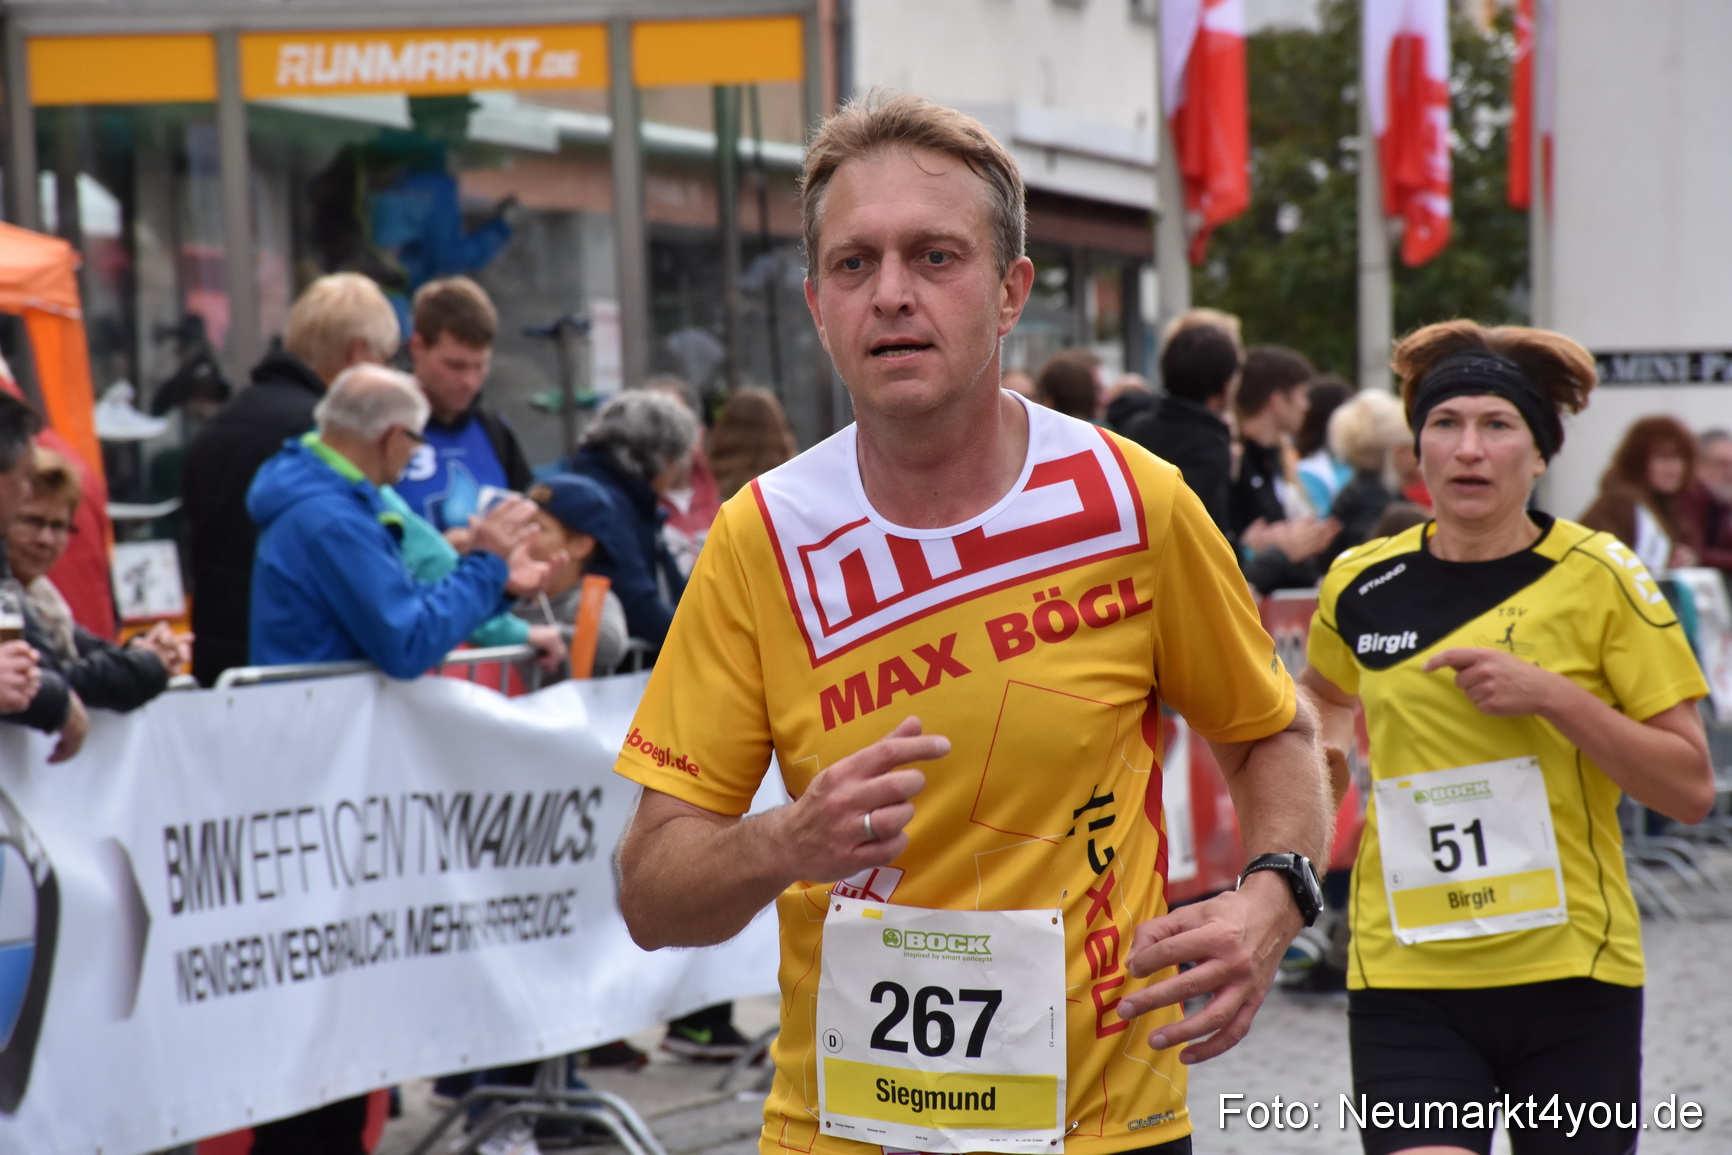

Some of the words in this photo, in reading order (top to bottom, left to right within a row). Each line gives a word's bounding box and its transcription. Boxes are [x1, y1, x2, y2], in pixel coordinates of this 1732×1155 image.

[1358, 563, 1407, 596] STANNO
[1497, 607, 1528, 617] TSV
[819, 632, 972, 732] MAX
[985, 576, 1153, 662] BÖGL
[1357, 631, 1418, 654] Birgit
[1430, 780, 1492, 803] BOCK
[1429, 818, 1488, 873] 51
[163, 816, 244, 916] BMW
[1447, 887, 1497, 910] Birgit
[904, 930, 992, 955] BOCK
[903, 951, 931, 960] inspired
[932, 952, 940, 961] by
[869, 981, 1003, 1057] 267
[828, 1034, 837, 1048] D
[875, 1077, 996, 1113] Siegmund
